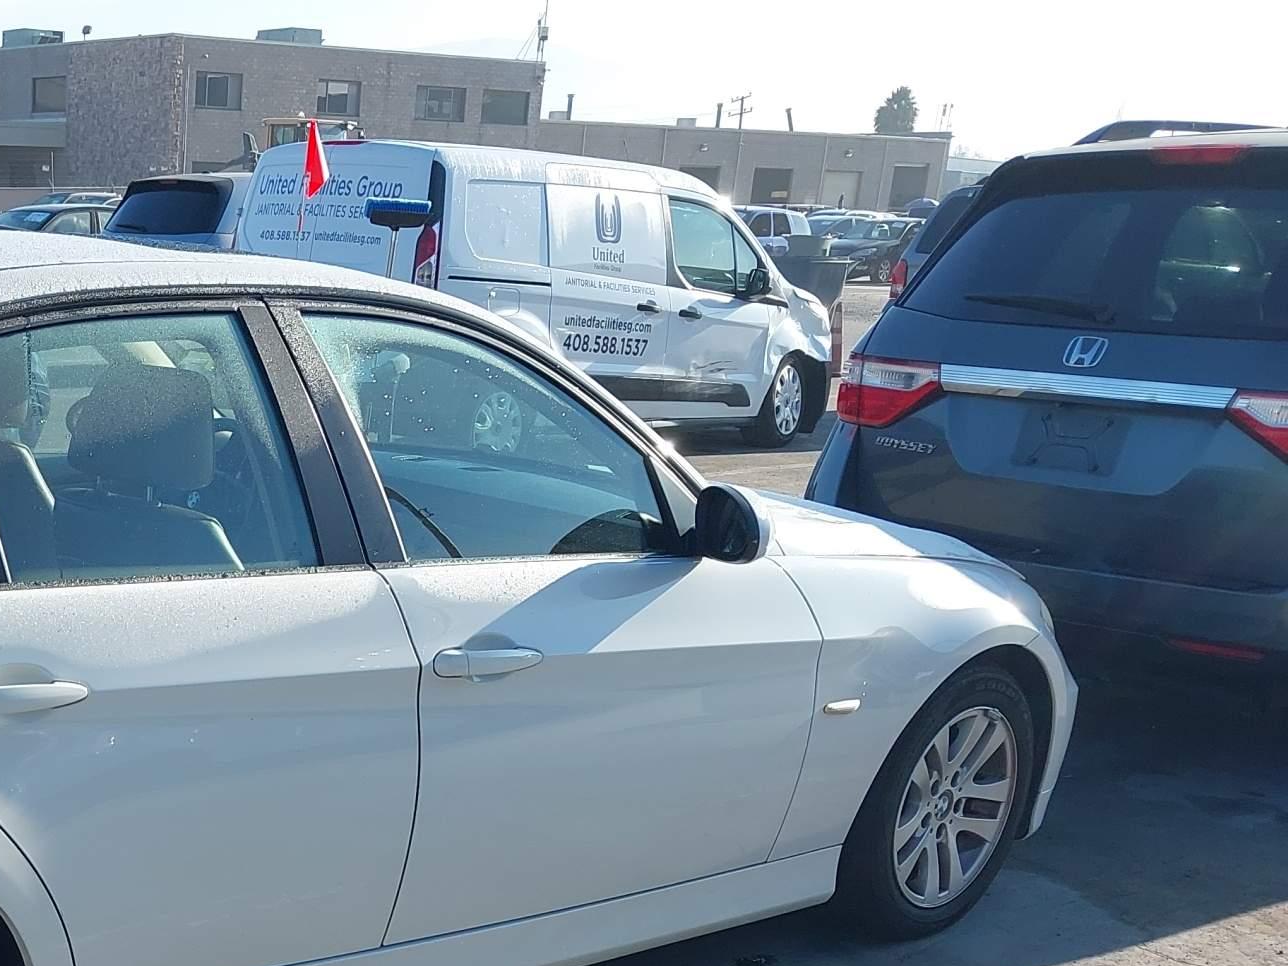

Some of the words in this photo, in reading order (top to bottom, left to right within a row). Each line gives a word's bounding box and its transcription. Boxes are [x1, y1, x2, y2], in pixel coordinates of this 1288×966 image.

[259, 173, 297, 195] United
[357, 175, 403, 198] Group
[255, 202, 295, 216] JANITORIAL
[304, 203, 347, 218] FACILITIES
[314, 232, 381, 246] unitedfacilitiesg.com
[592, 246, 625, 264] United
[565, 276, 597, 289] JANITORIAL
[603, 281, 631, 293] FACILITIES
[632, 285, 656, 296] SERVICES
[564, 314, 652, 334] unitedfacilitiesg.com
[563, 333, 649, 357] 408.588.1537
[875, 436, 937, 454] ODYSSEY
